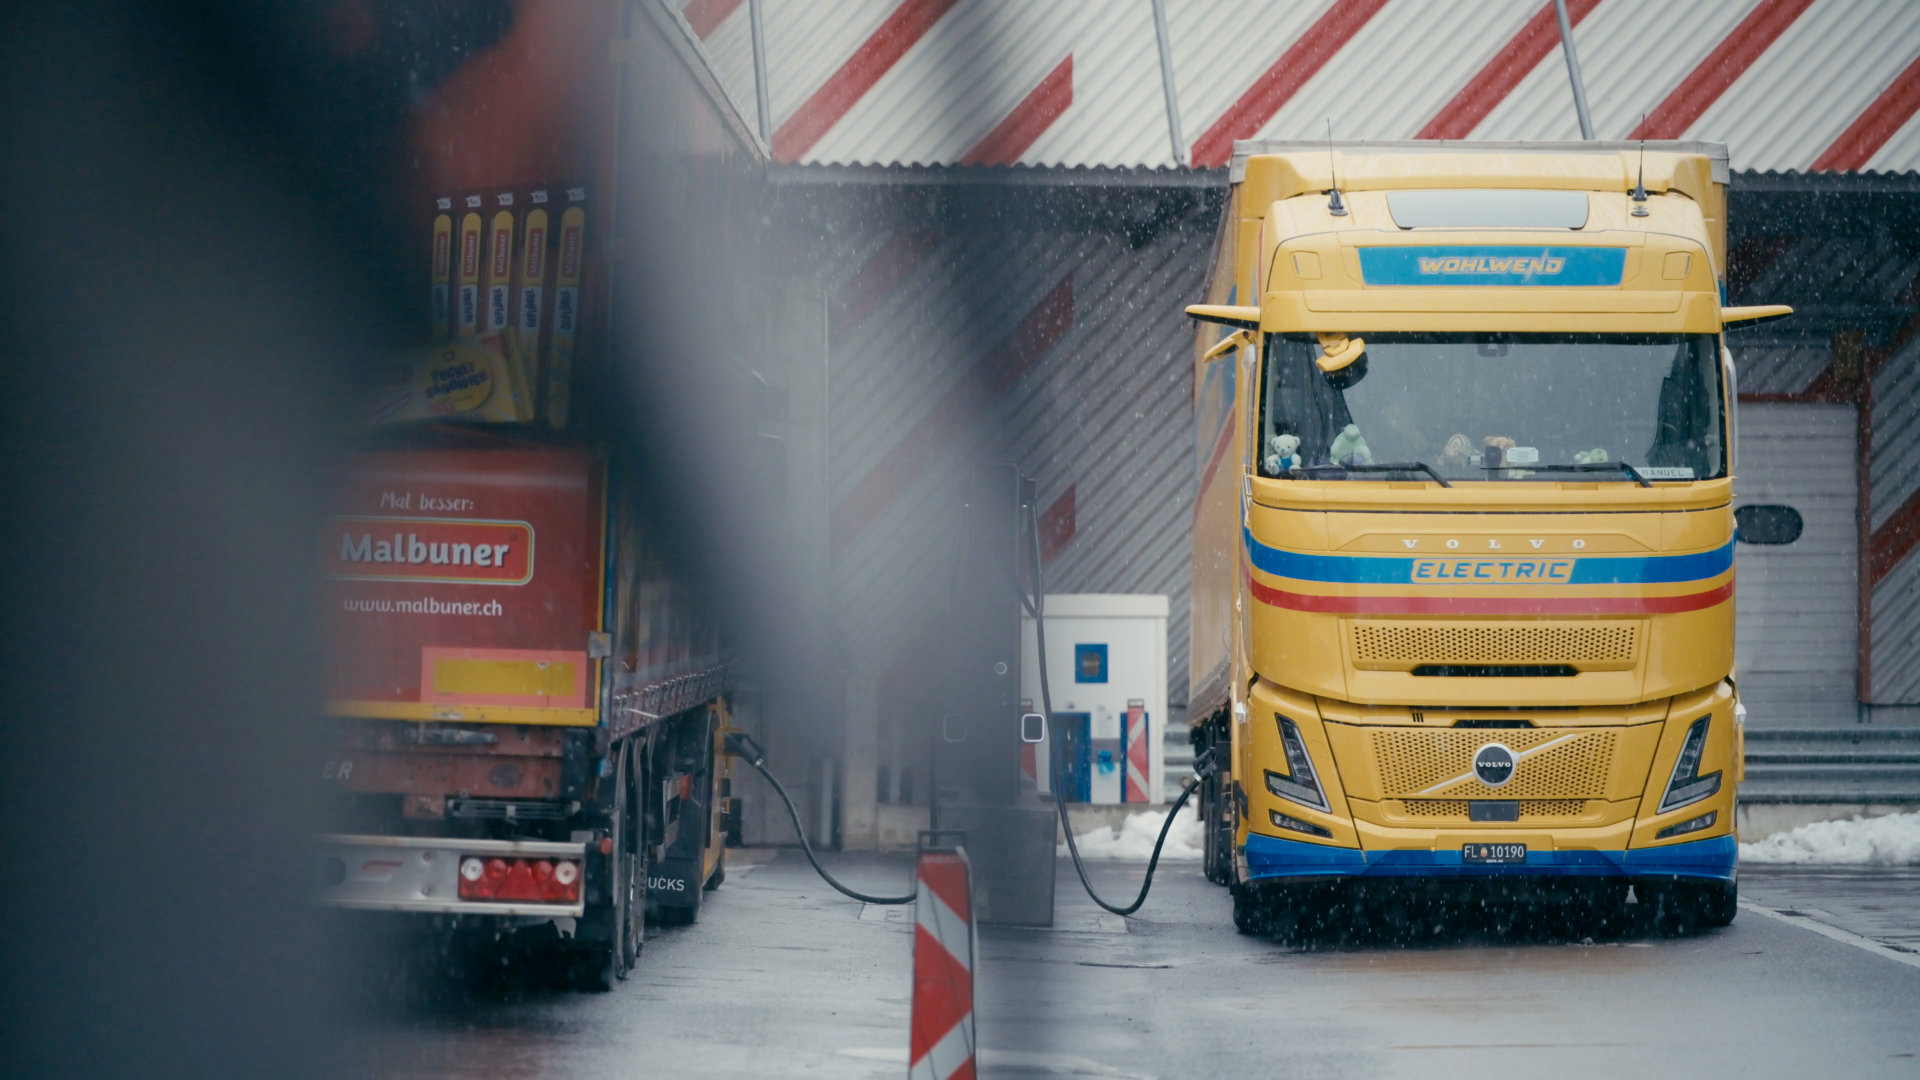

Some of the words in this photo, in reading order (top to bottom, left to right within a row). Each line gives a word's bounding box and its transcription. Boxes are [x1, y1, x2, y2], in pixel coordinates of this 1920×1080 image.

[467, 234, 475, 273] Malbuner
[498, 233, 506, 273] Malbuner
[531, 232, 540, 274] Malbuner
[566, 231, 576, 274] Malbuner
[1418, 255, 1566, 275] WOHLWEND
[430, 362, 476, 383] POCKET
[425, 371, 489, 399] SANDWICH
[1641, 468, 1685, 477] MANUEL
[381, 491, 411, 509] Mal
[420, 493, 474, 511] besser:
[341, 533, 509, 567] Malbuner
[1402, 539, 1586, 549] VOLVO
[1415, 562, 1570, 579] ELECTRIC
[344, 597, 502, 616] www.malbuner.ch
[321, 760, 355, 780] ER
[1464, 845, 1478, 858] FL
[1490, 845, 1525, 858] 10190
[648, 876, 685, 892] UCKS
